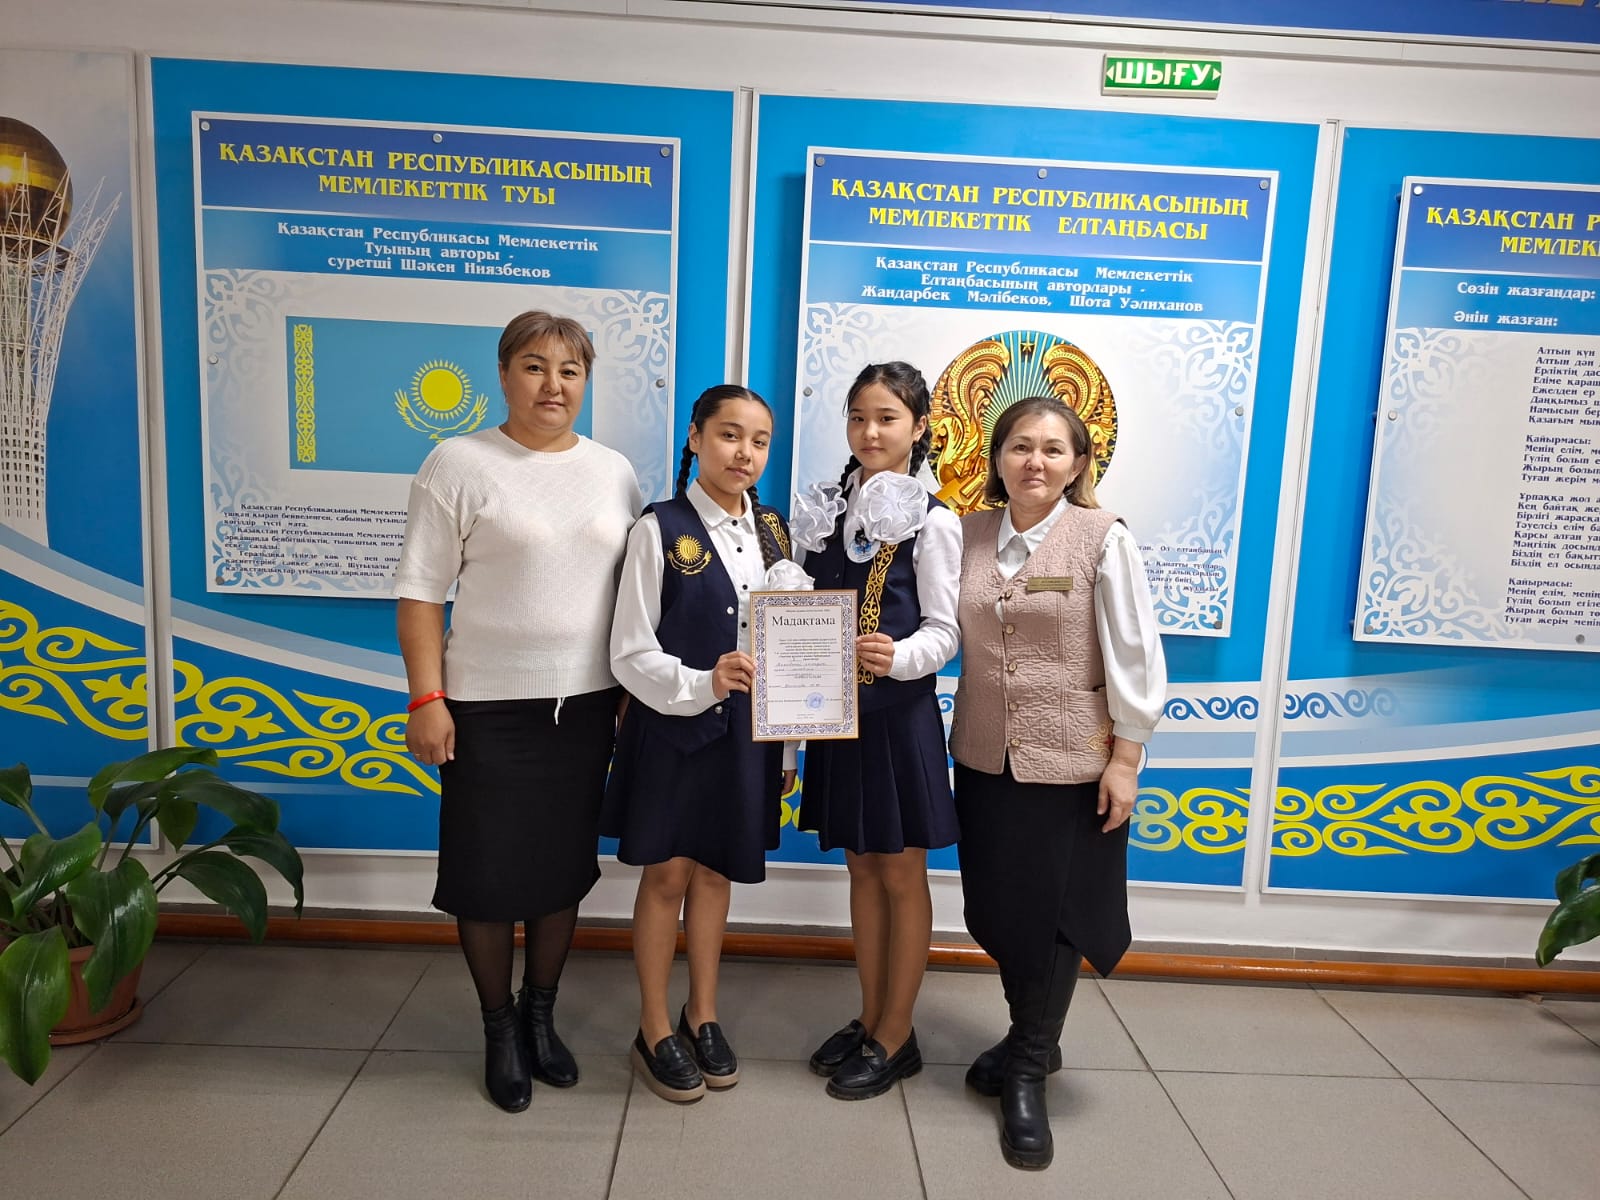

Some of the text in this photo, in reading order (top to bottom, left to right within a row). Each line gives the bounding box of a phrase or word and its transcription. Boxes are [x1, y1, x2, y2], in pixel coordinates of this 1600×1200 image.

[1115, 61, 1212, 86] ШЫҒУ
[219, 143, 653, 188] ҚАЗАҚСТАН РЕСПУБЛИКАСЫНЫҢ
[319, 174, 556, 205] МЕМЛЕКЕТТІК ТУЫ
[831, 178, 1249, 218] ҚАЗАҚСТАН РЕСПУБЛИКАСЫНЫҢ
[869, 208, 1209, 241] МЕМЛЕКЕТТІК ЕЛТАҢБАСЫ
[1426, 206, 1575, 231] ҚАЗАҚСТАН
[278, 222, 599, 252] Қазақстан Республикасы Мемлекеттік
[1500, 236, 1600, 257] МЕМЛЕК
[365, 242, 432, 260] Туының
[441, 248, 500, 264] авторы
[328, 256, 551, 279] суретші Шәкен Ниязбеков
[875, 256, 1193, 283] Қазақстан Республикасы Мемлекеттік
[921, 274, 1039, 292] Елтаңбасының
[1047, 281, 1132, 296] авторлары
[1457, 281, 1596, 302] Сөзін жазғандар:
[861, 285, 1204, 312] Жандарбек Мәлібеков, Шота Уәлиханов
[1453, 310, 1558, 327] Әнін жазған:
[1536, 356, 1570, 365] Алтын
[1537, 346, 1571, 355] Алтын
[1532, 386, 1578, 395] Ежелден
[772, 615, 836, 627] Мадақтама
